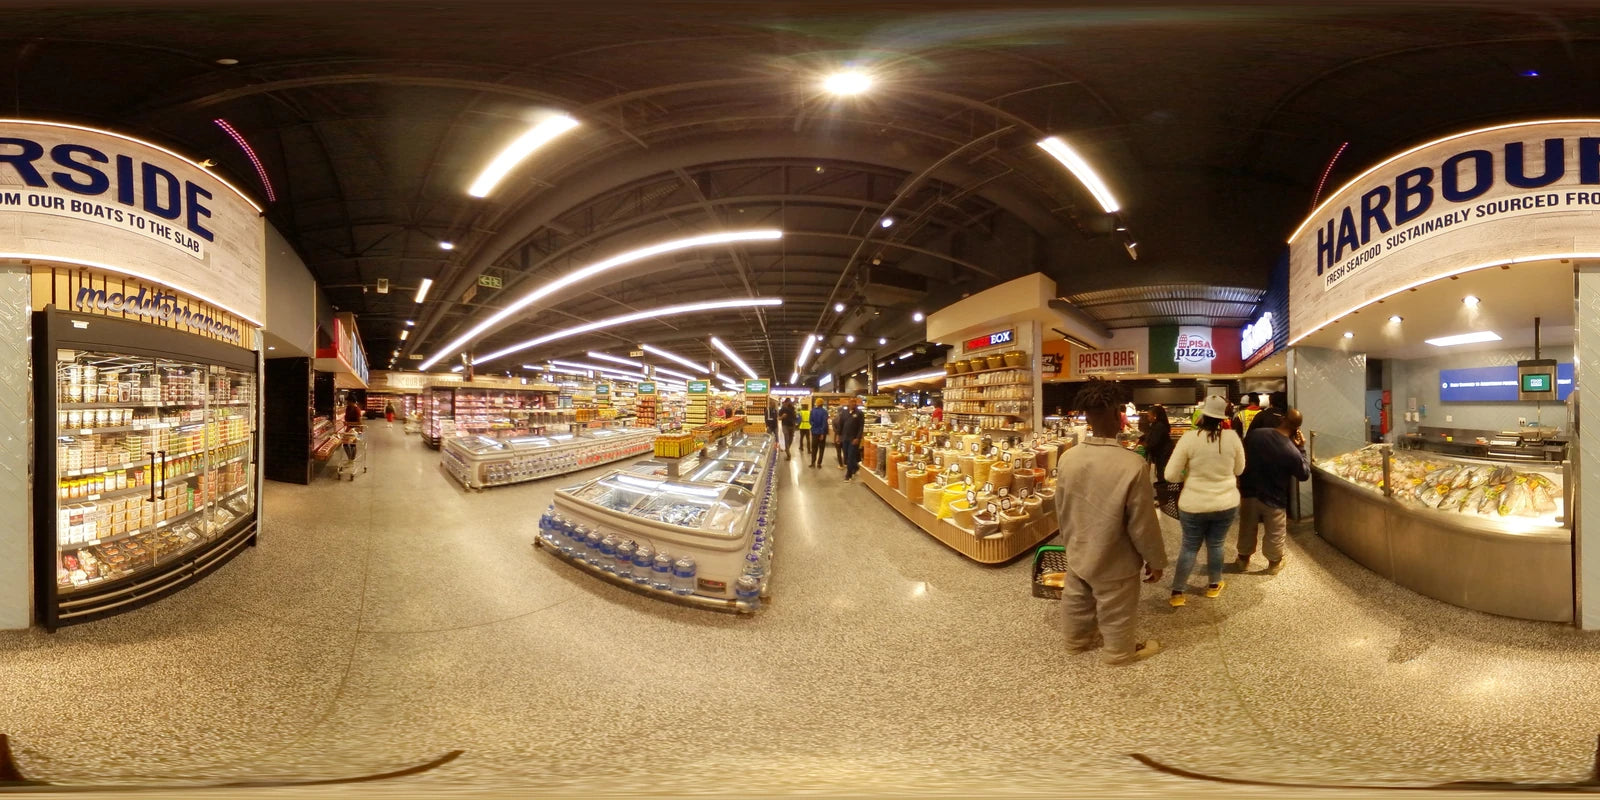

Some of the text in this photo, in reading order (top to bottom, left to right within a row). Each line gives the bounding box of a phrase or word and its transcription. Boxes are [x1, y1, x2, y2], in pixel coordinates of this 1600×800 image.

[28, 194, 65, 210] OUR
[70, 200, 124, 223] BOATS
[127, 213, 145, 230] TO
[149, 219, 172, 240] THE
[174, 230, 200, 253] SLAB
[1326, 267, 1346, 287] FRESH
[1346, 243, 1381, 273] SEAFOOD
[1386, 208, 1472, 250] SUSTAINABLY
[1476, 193, 1559, 218] SOURCED
[76, 287, 241, 343] mediterranean
[1079, 350, 1135, 368] PASTA BAR
[1176, 346, 1215, 360] pizza
[1189, 340, 1211, 348] PISA
